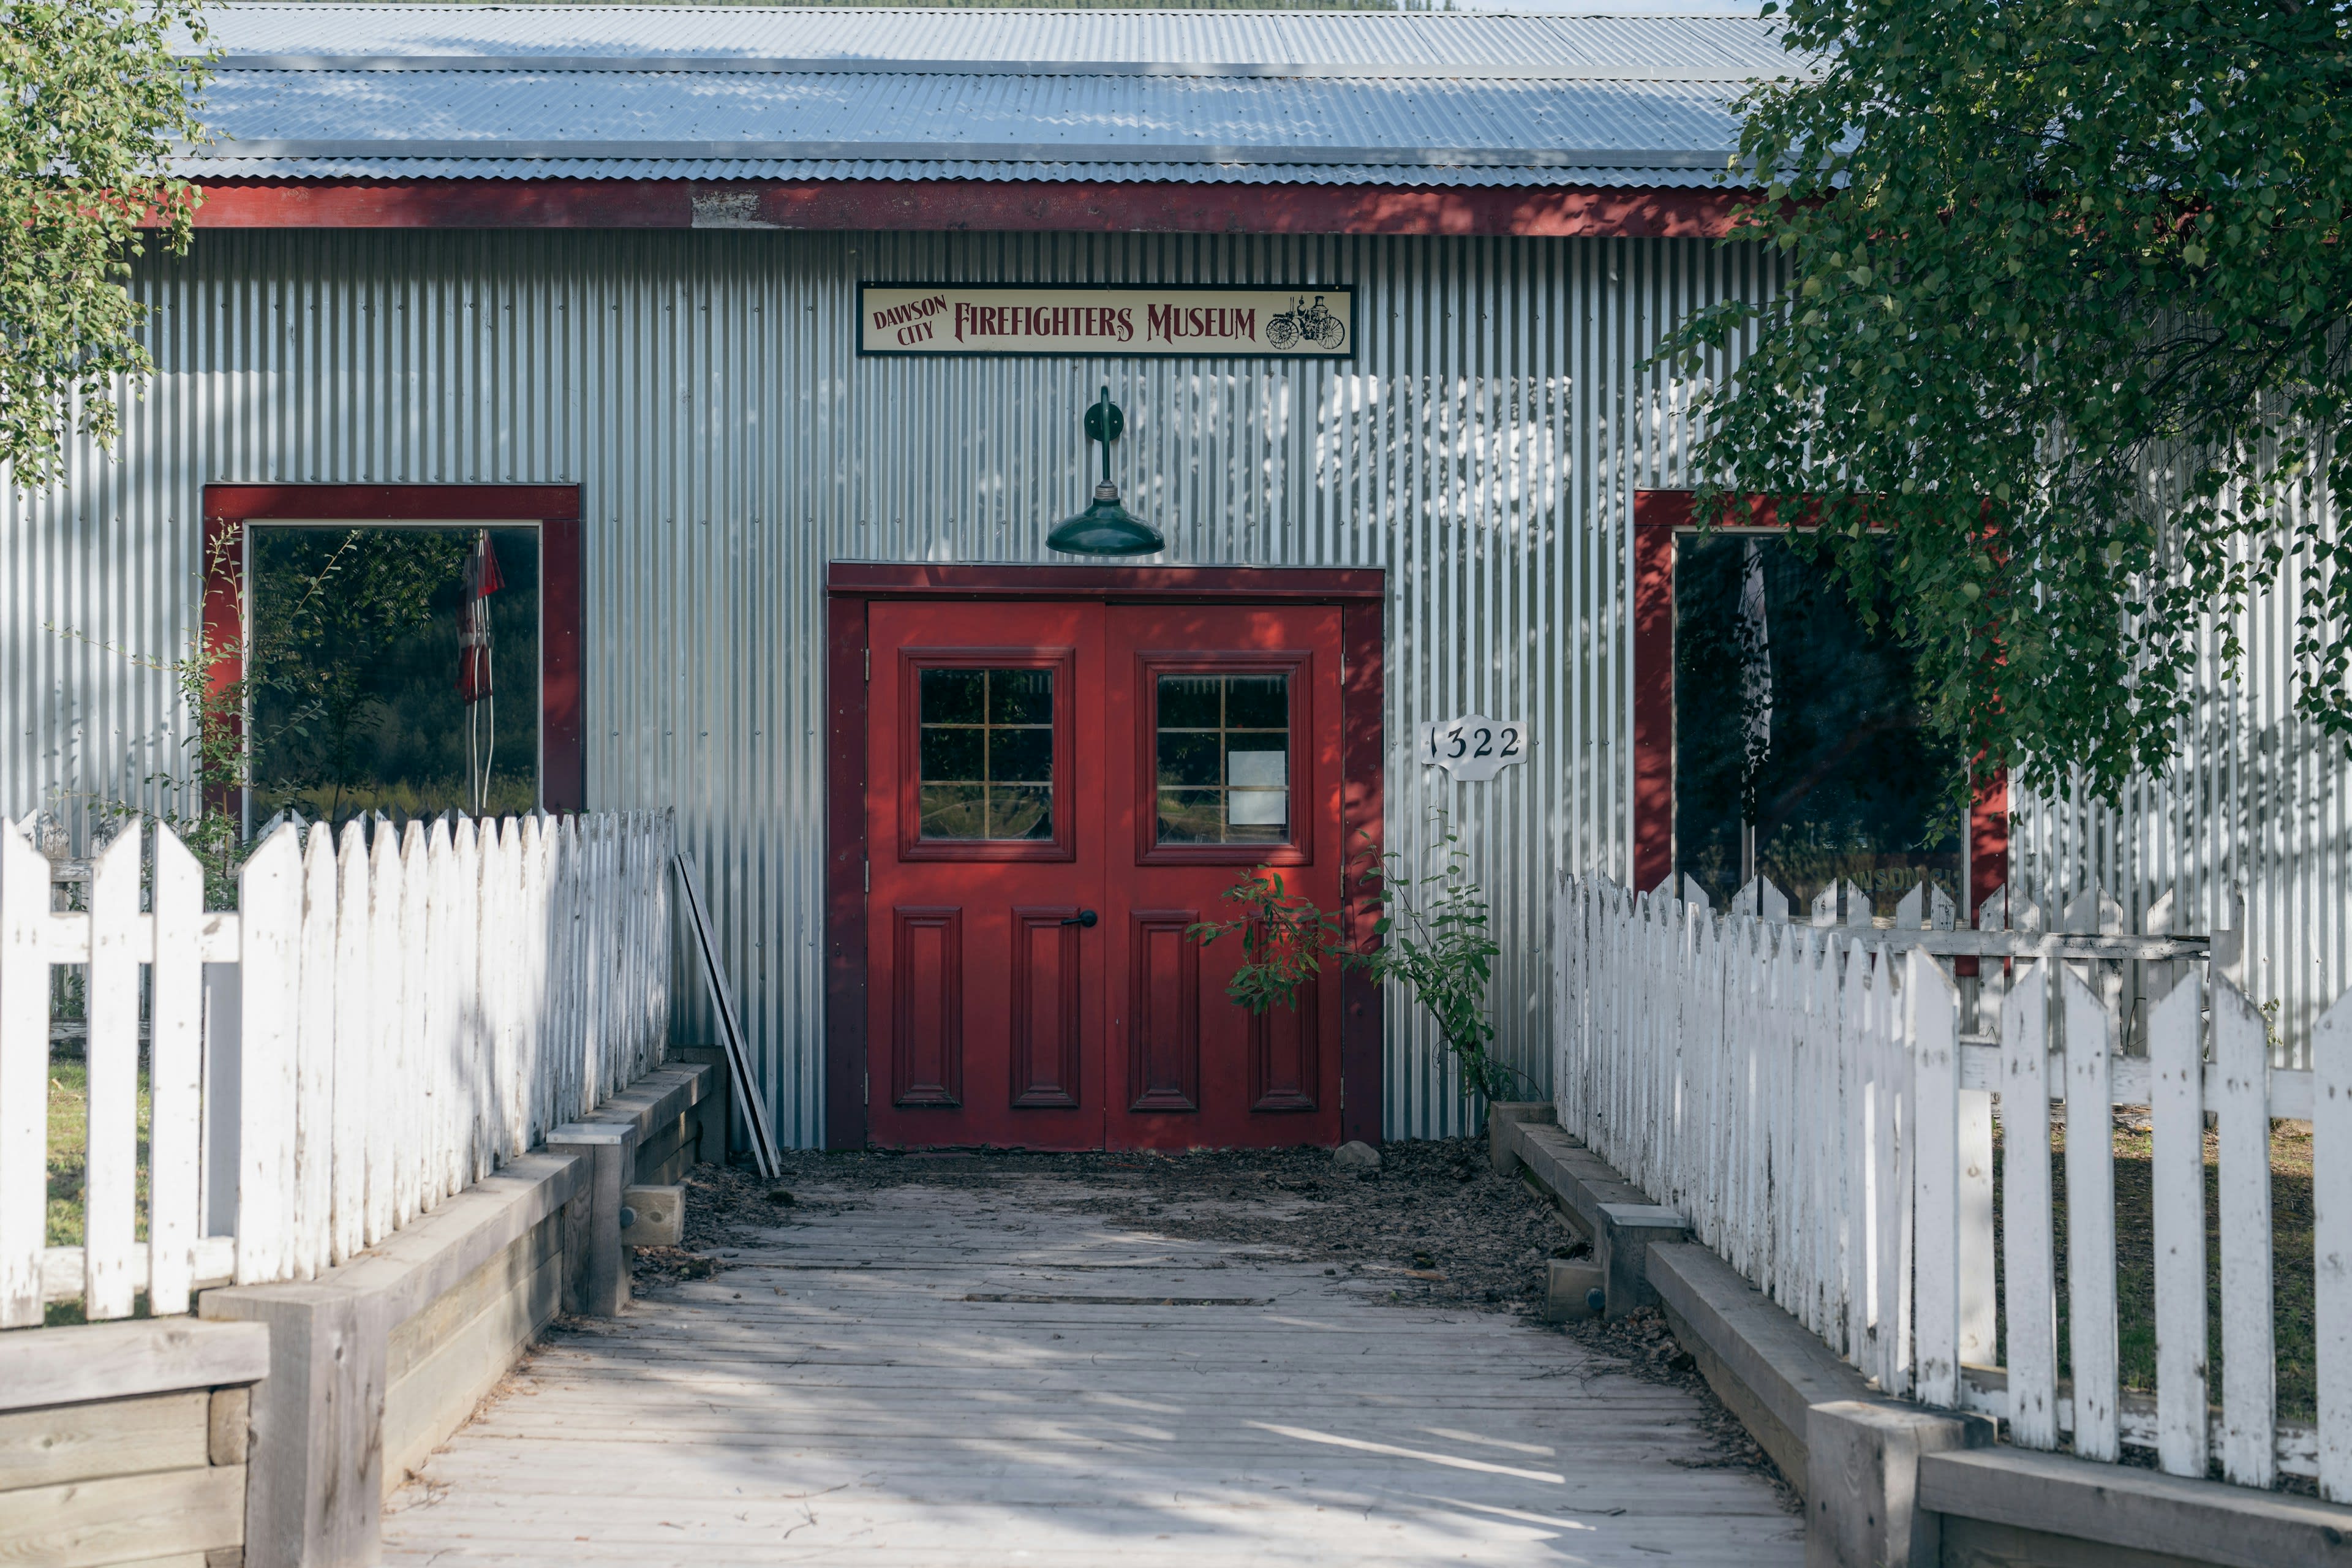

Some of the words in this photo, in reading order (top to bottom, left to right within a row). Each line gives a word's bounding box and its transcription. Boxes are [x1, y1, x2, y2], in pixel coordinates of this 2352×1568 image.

[873, 294, 948, 330] DAWSON
[954, 303, 1134, 344] FIREFIGHTERS
[1147, 304, 1256, 345] MUSEUM
[897, 320, 934, 346] CITY
[1431, 726, 1519, 759] 1322
